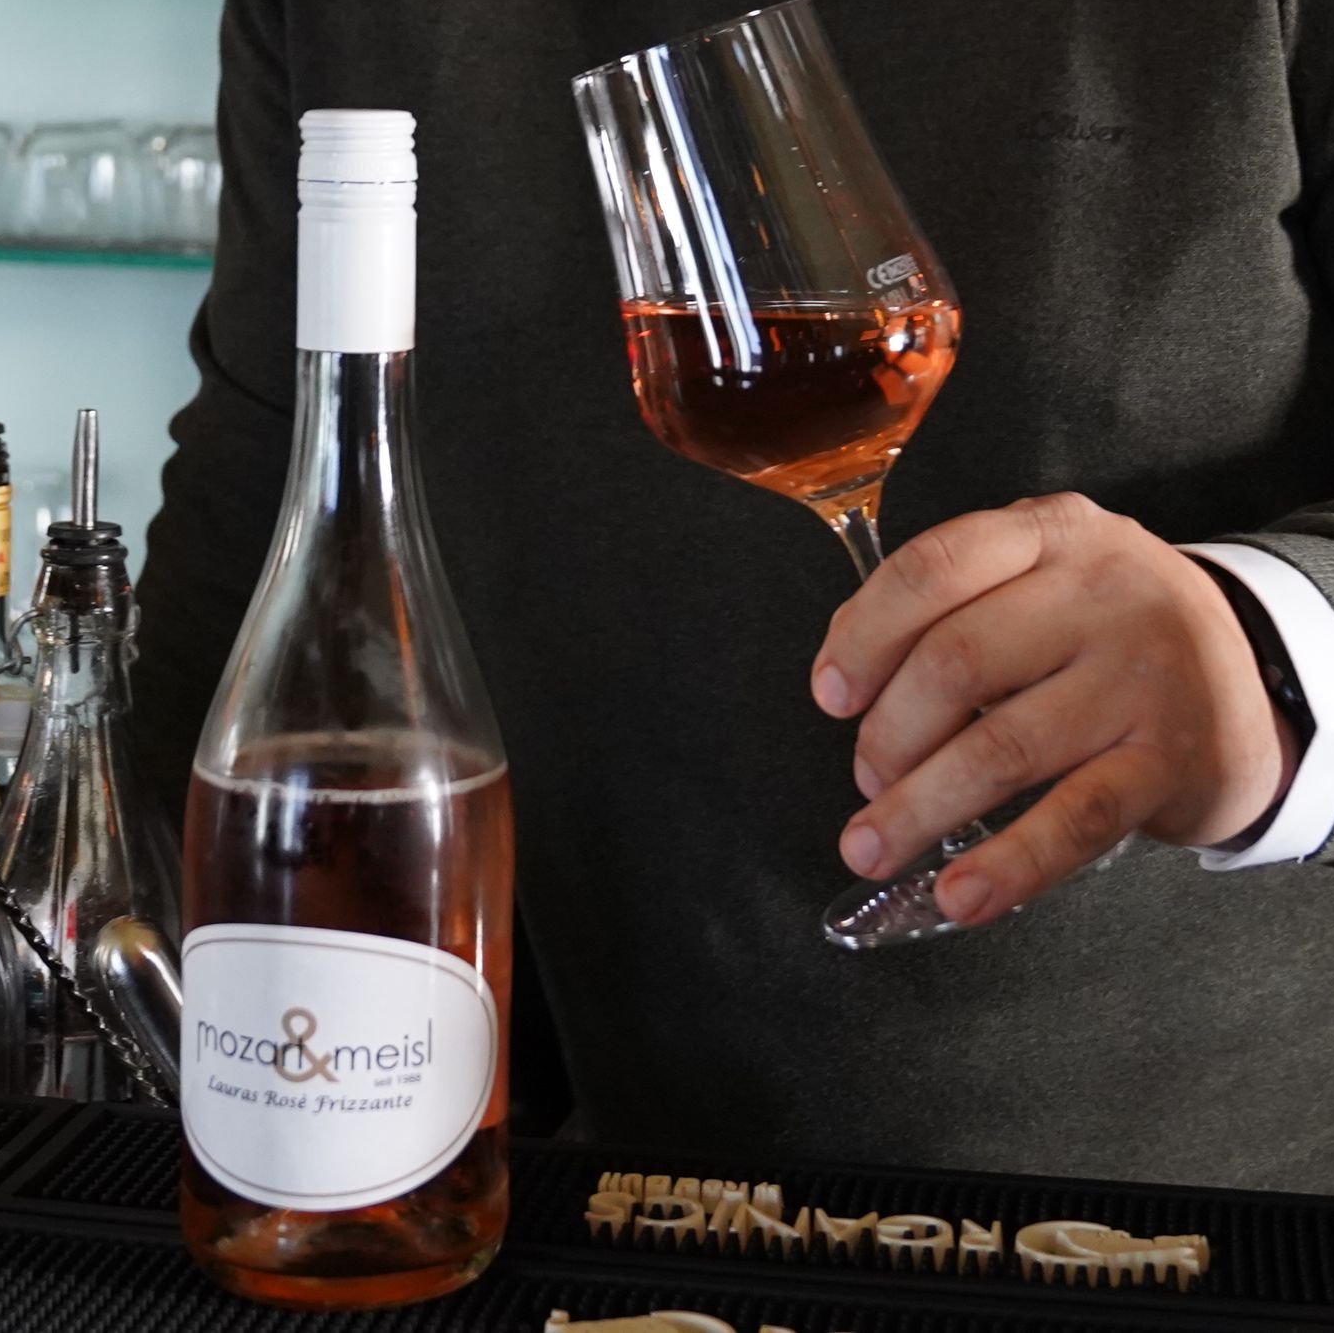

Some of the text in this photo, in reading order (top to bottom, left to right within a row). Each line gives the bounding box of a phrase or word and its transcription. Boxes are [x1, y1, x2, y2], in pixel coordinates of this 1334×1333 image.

[196, 1006, 433, 1084] mozart & meisl
[207, 1073, 415, 1115] Lauras Rosé Frizzante
